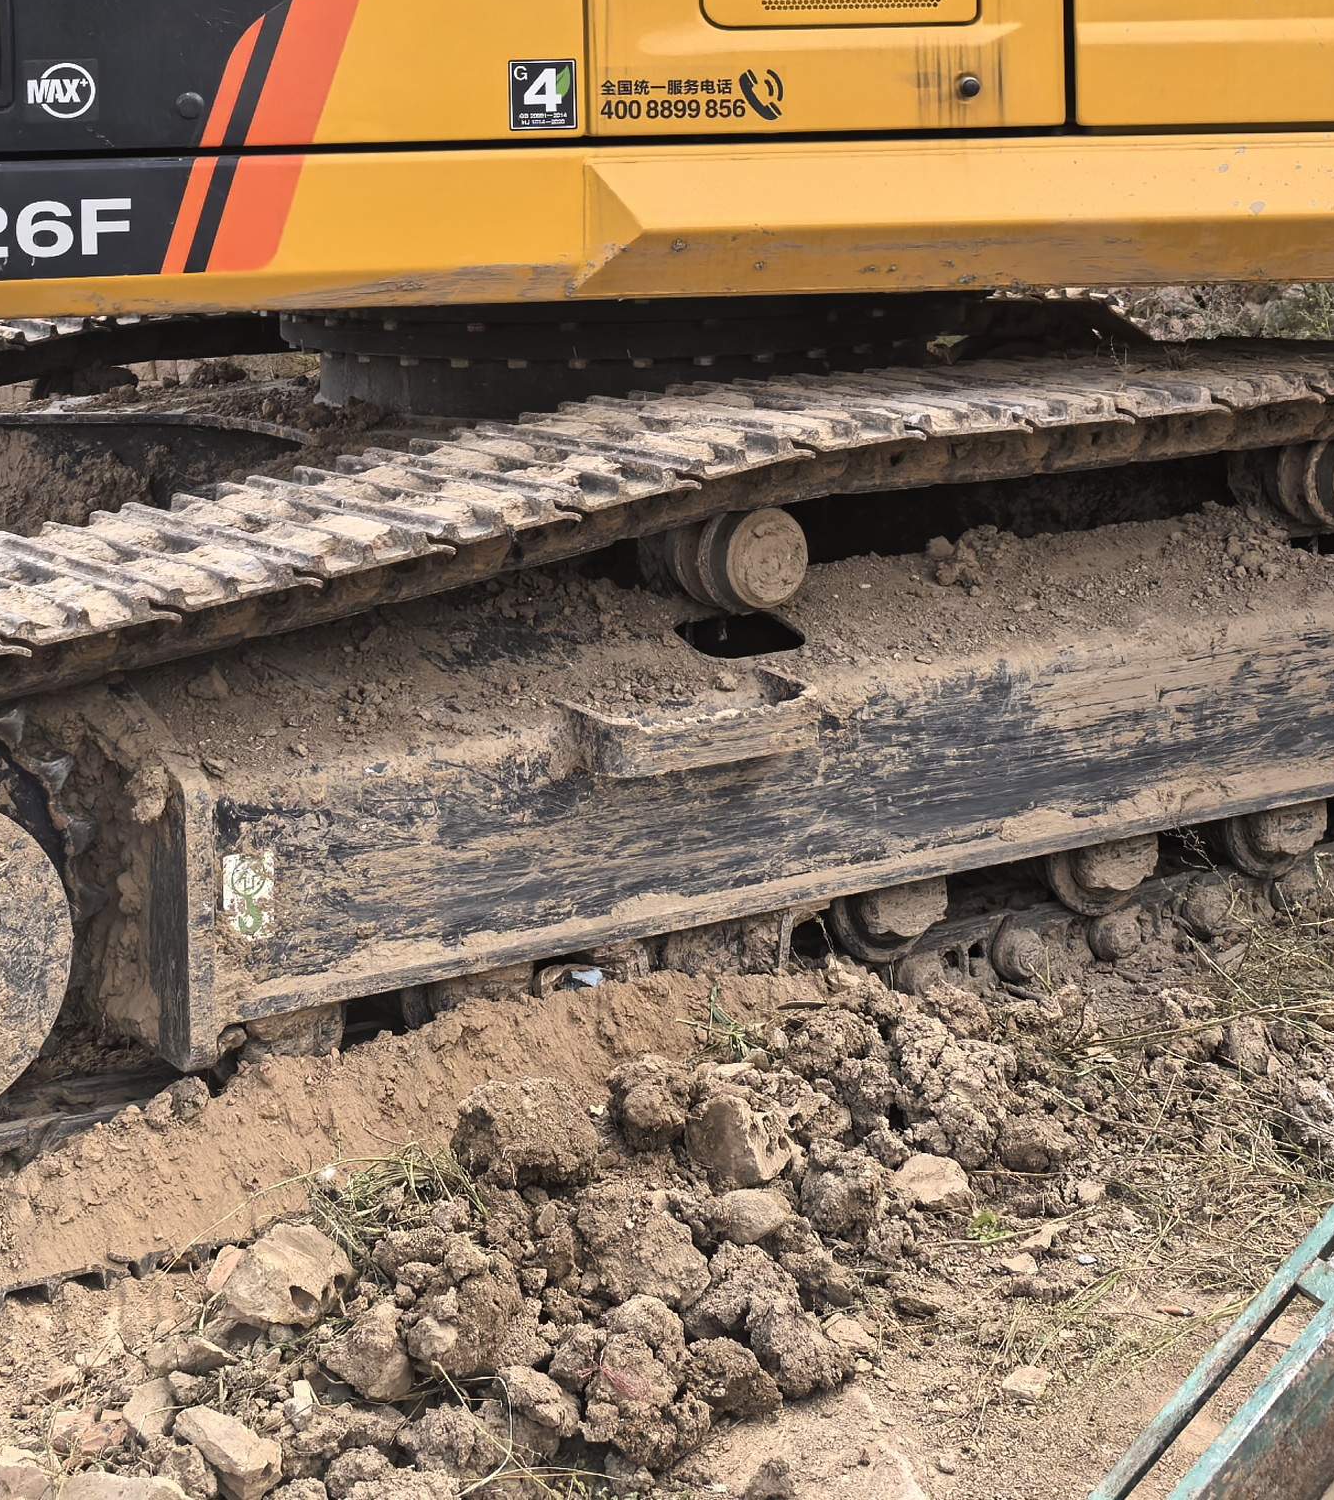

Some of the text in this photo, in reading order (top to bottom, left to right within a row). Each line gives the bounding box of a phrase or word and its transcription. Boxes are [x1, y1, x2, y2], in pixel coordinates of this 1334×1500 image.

[513, 66, 527, 80] G
[523, 68, 562, 112] 4
[601, 79, 732, 96] 全国统一服务电话
[601, 99, 746, 119] 400 8899 856
